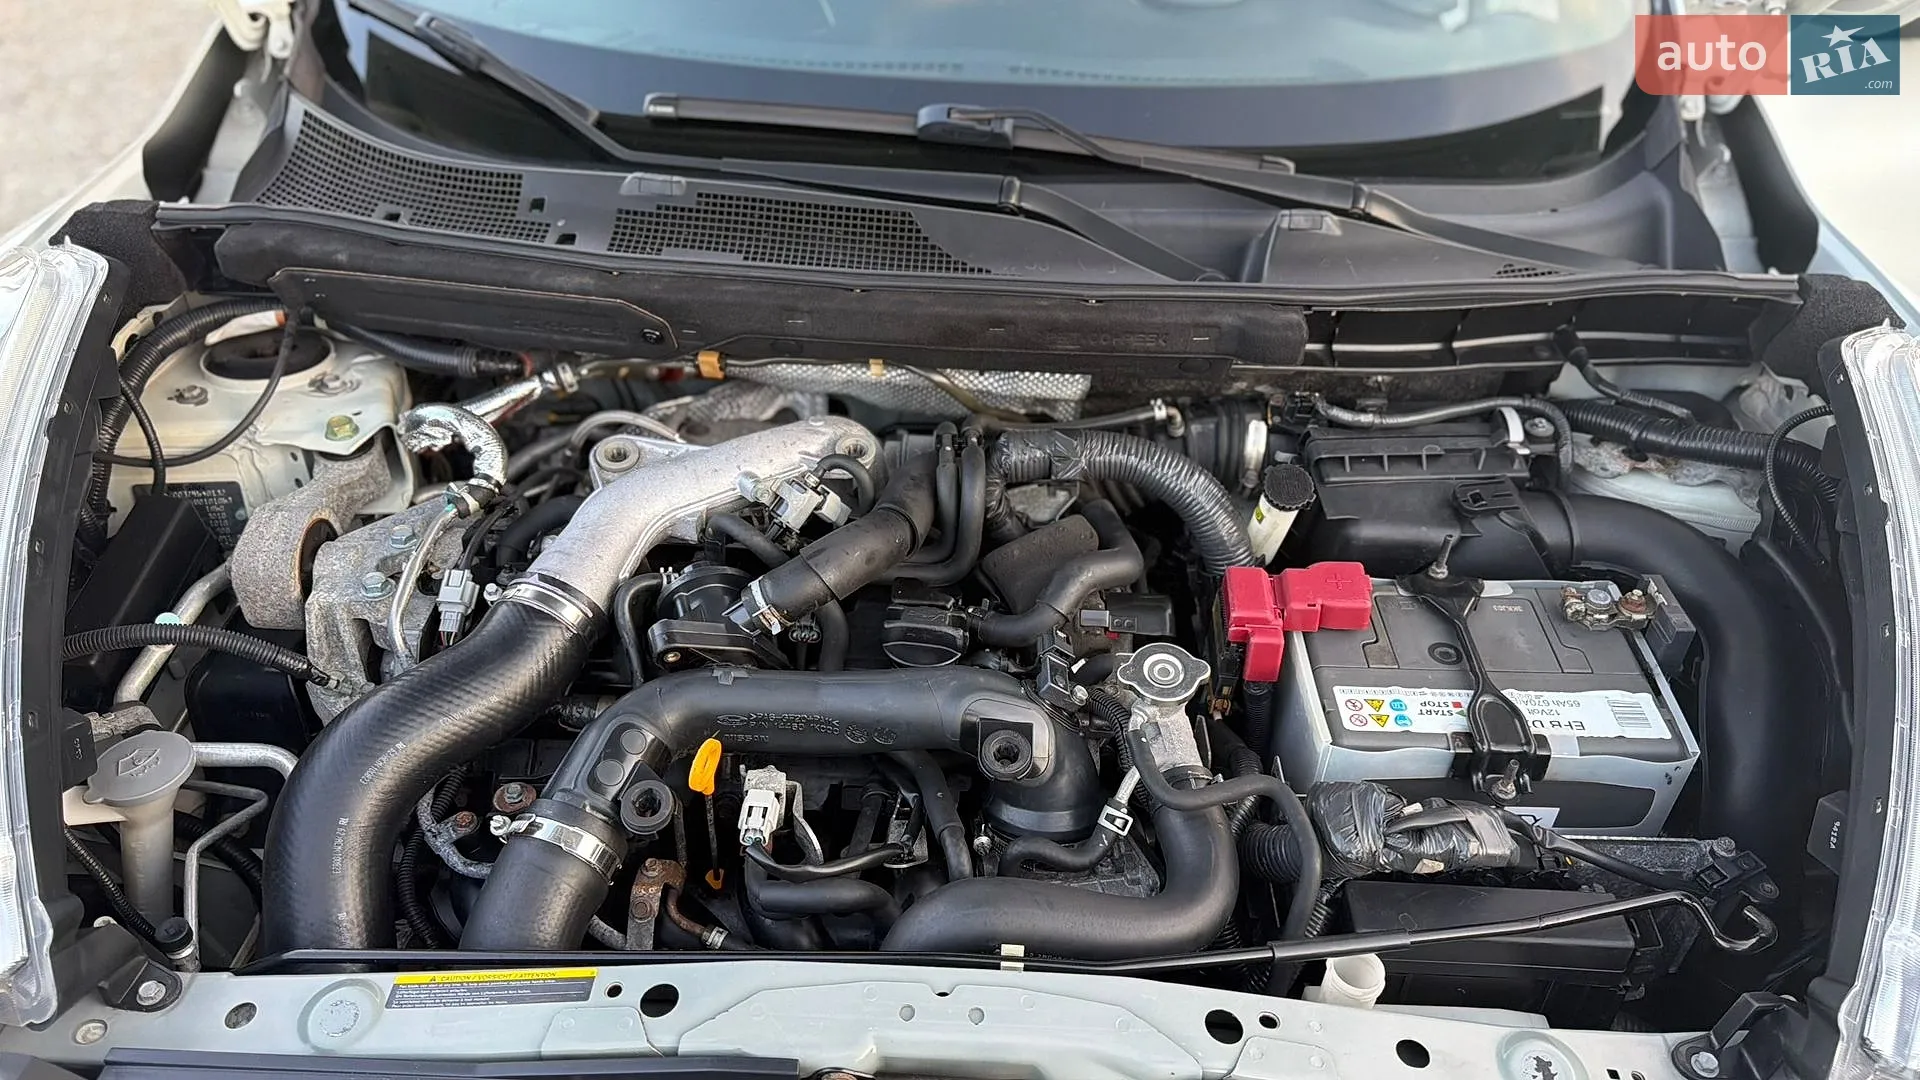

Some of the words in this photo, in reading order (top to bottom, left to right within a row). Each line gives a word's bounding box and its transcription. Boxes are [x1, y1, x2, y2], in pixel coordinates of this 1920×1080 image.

[1419, 700, 1449, 709] STOP
[1551, 699, 1581, 707] 65Ah
[1417, 708, 1454, 717] START
[1526, 708, 1560, 716] 12Volt
[440, 974, 471, 982] CAUTION
[477, 973, 513, 981] VORSICHT
[518, 971, 556, 980] ATTENTION
